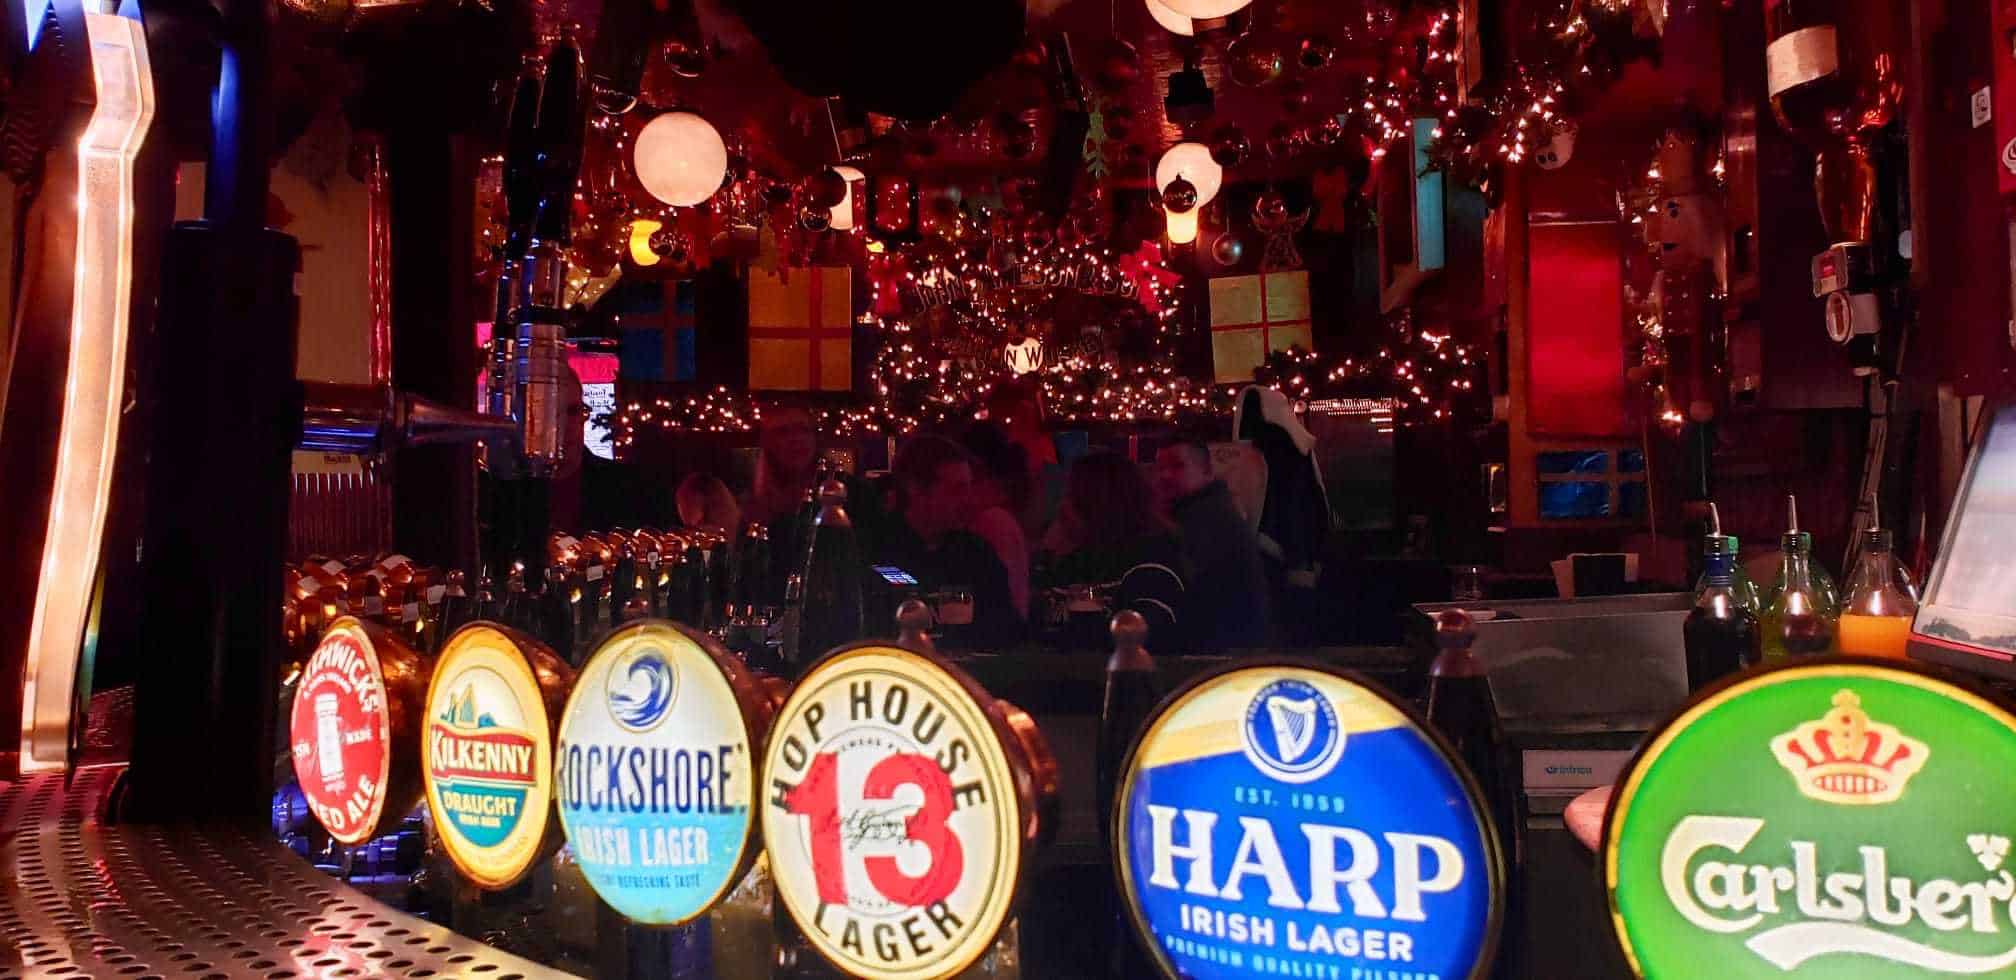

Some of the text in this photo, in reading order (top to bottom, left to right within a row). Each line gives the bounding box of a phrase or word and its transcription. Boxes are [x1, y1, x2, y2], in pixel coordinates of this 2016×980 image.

[431, 729, 532, 774] KILKENNY
[771, 680, 987, 813] HOP HOUSE
[347, 774, 376, 824] ALE
[443, 791, 518, 817] DRAUGHT
[786, 751, 965, 907] 13
[639, 827, 710, 867] LAGER
[1147, 804, 1464, 922] HARP
[1661, 815, 2016, 932] Carlsber
[813, 901, 963, 963] LAGER
[1166, 934, 1243, 967] PREMIUM
[1253, 954, 1340, 980] QUALITY
[1180, 903, 1413, 963] IRISH LAGER
